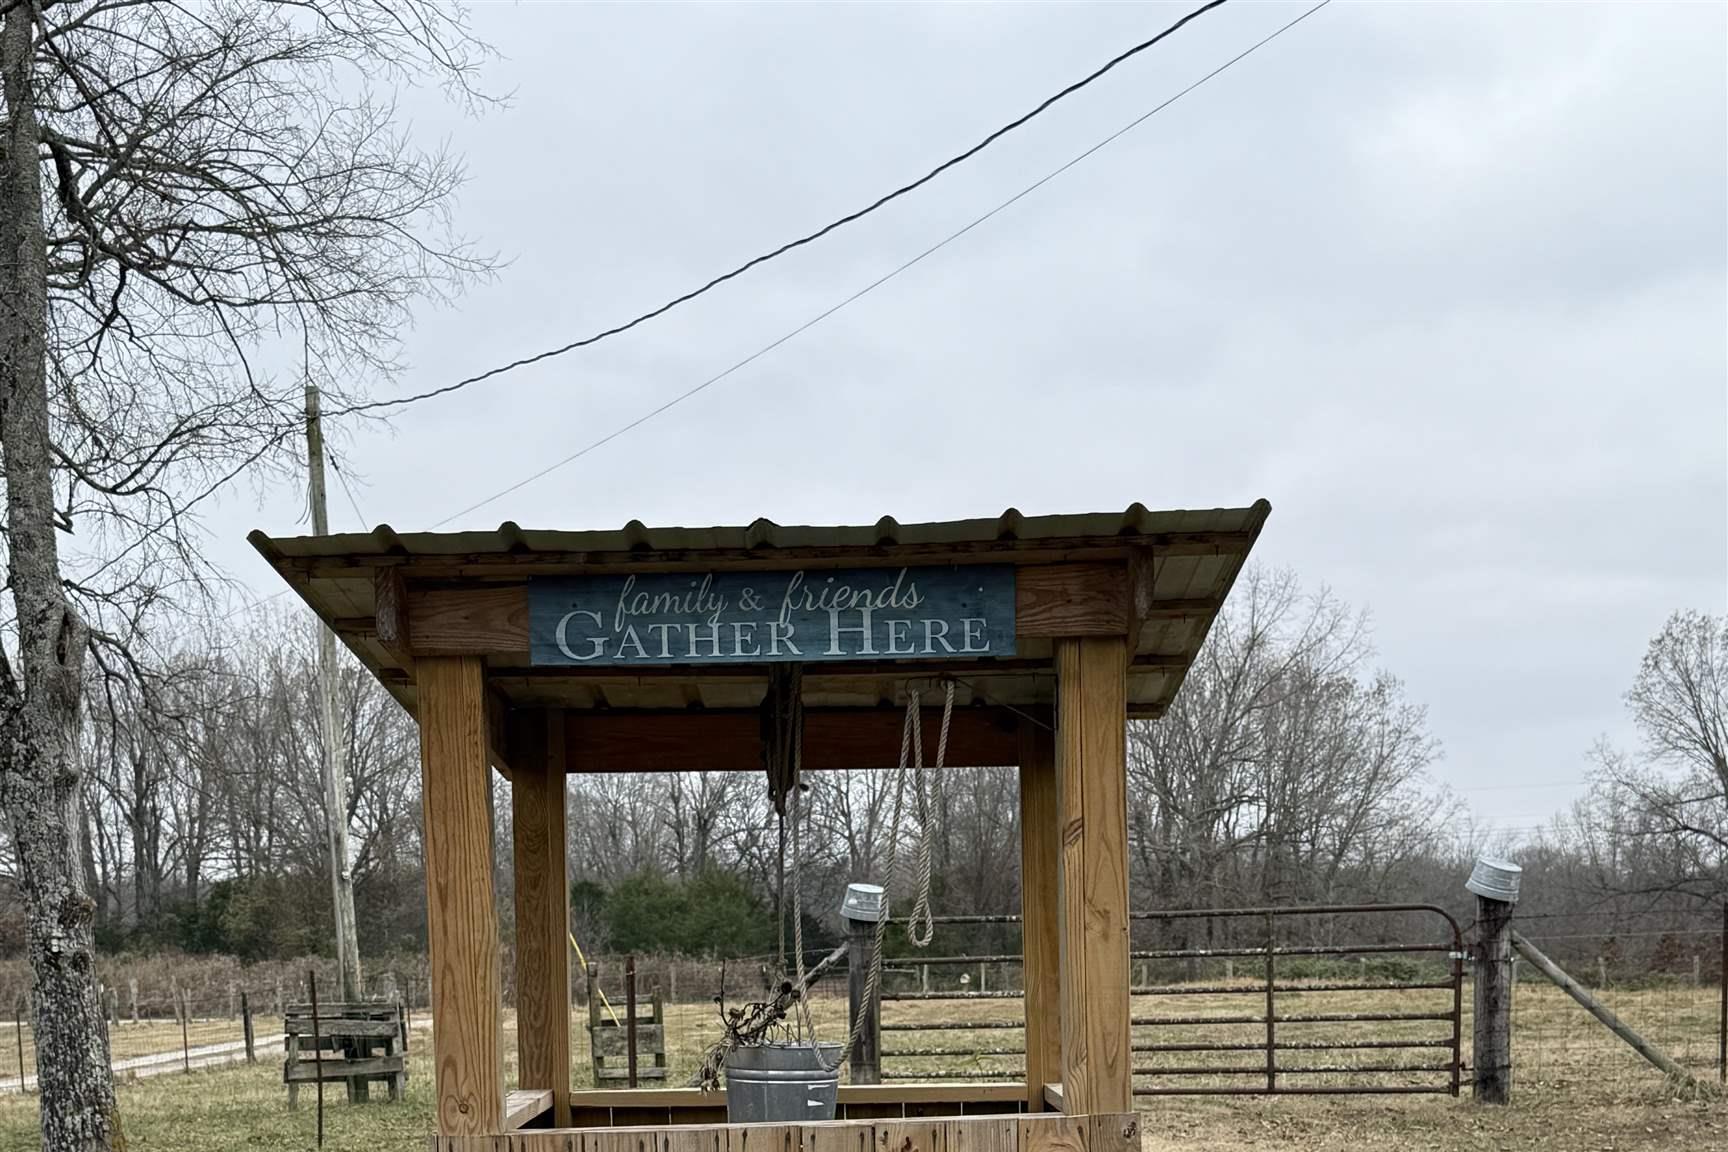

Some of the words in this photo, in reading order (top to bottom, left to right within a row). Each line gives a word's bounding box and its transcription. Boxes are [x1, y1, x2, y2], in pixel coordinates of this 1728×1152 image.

[615, 574, 728, 632] family
[739, 587, 764, 611] &
[780, 567, 924, 628] friends
[555, 610, 803, 660] GATHER
[823, 606, 990, 656] HERE
